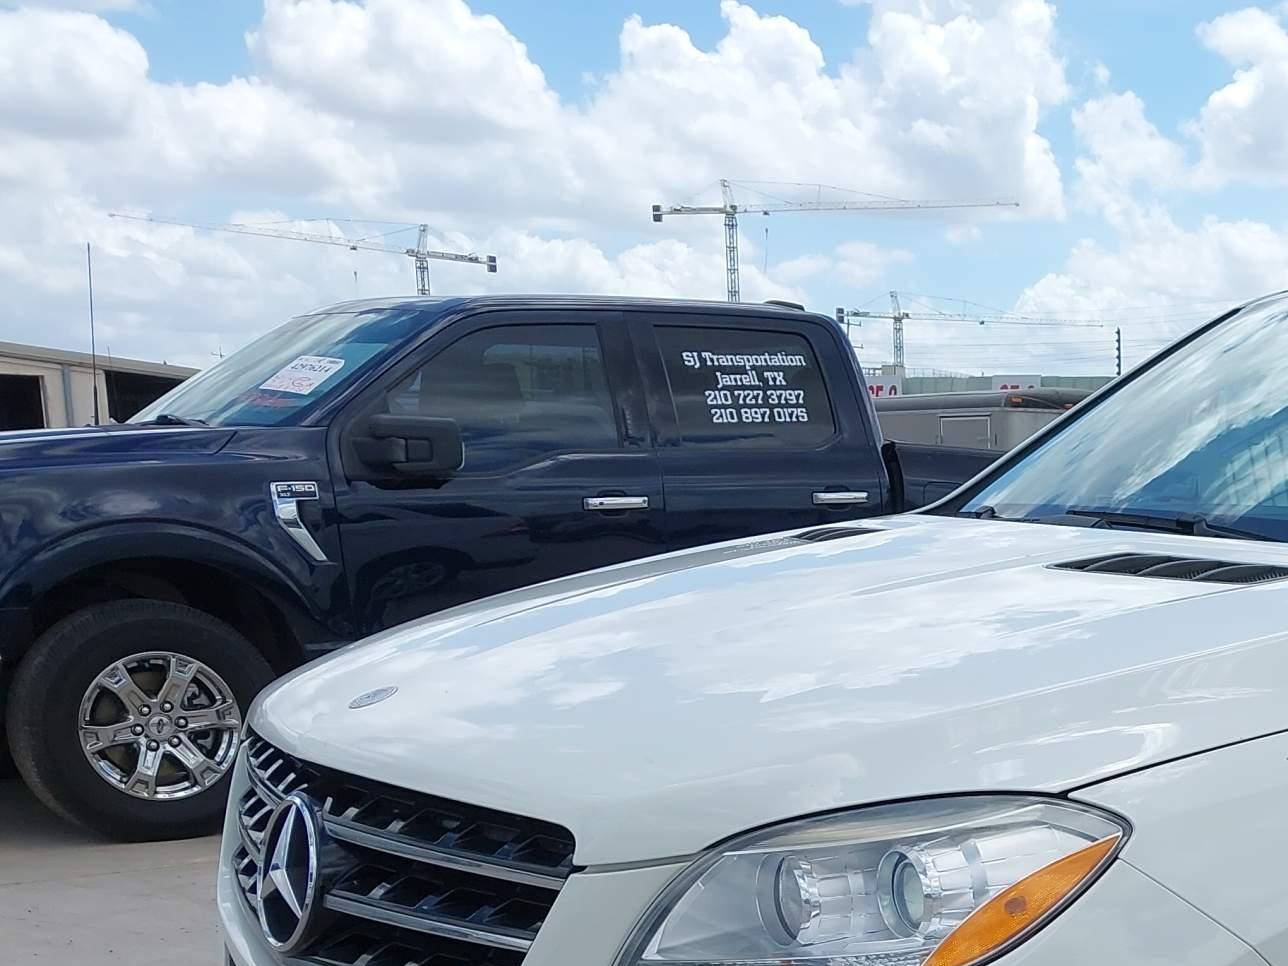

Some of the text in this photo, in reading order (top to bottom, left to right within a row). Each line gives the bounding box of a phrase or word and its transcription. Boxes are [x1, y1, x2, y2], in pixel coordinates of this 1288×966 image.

[681, 351, 807, 369] SJ Transportation
[716, 370, 787, 388] Jarrell, TX
[704, 390, 804, 405] 210 727 3797
[710, 407, 809, 423] 210 897 0175
[277, 484, 315, 492] F-150
